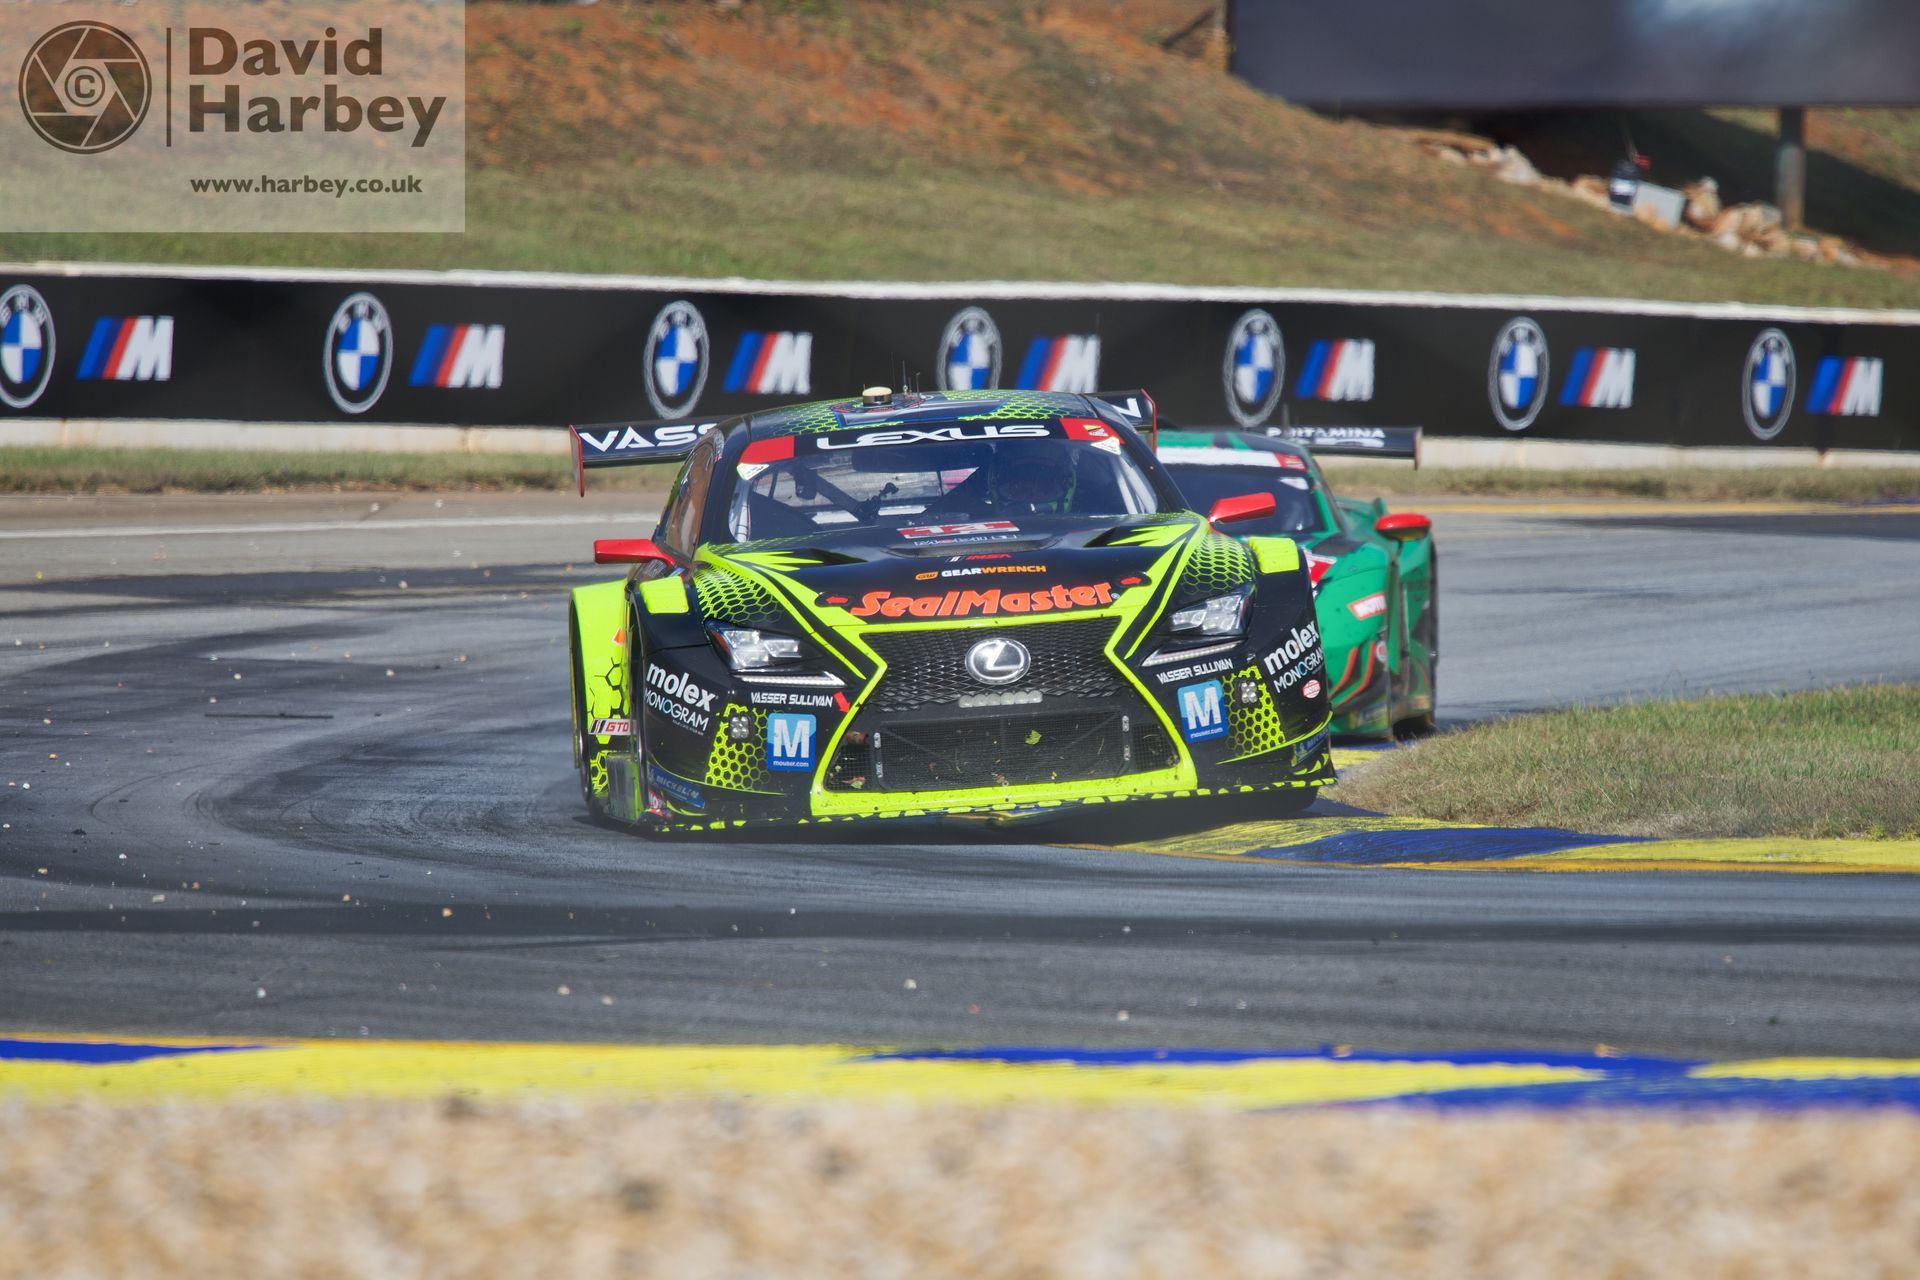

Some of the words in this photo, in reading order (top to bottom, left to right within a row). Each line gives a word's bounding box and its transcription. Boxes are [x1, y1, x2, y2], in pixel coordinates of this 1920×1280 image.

[816, 424, 1051, 450] LEXUS
[941, 565, 1047, 578] GEARWRENCH
[851, 584, 1113, 618] SealMaster
[1263, 620, 1320, 676] molex
[646, 663, 716, 712] molex
[1156, 666, 1194, 684] VASSER
[1193, 658, 1234, 676] SULLIVAN
[644, 687, 710, 732] MONOGRAM
[751, 692, 787, 704] VASSER
[788, 694, 834, 707] SULLIVAN
[1183, 686, 1222, 730] M
[773, 719, 811, 758] M
[773, 760, 810, 768] mouser.com
